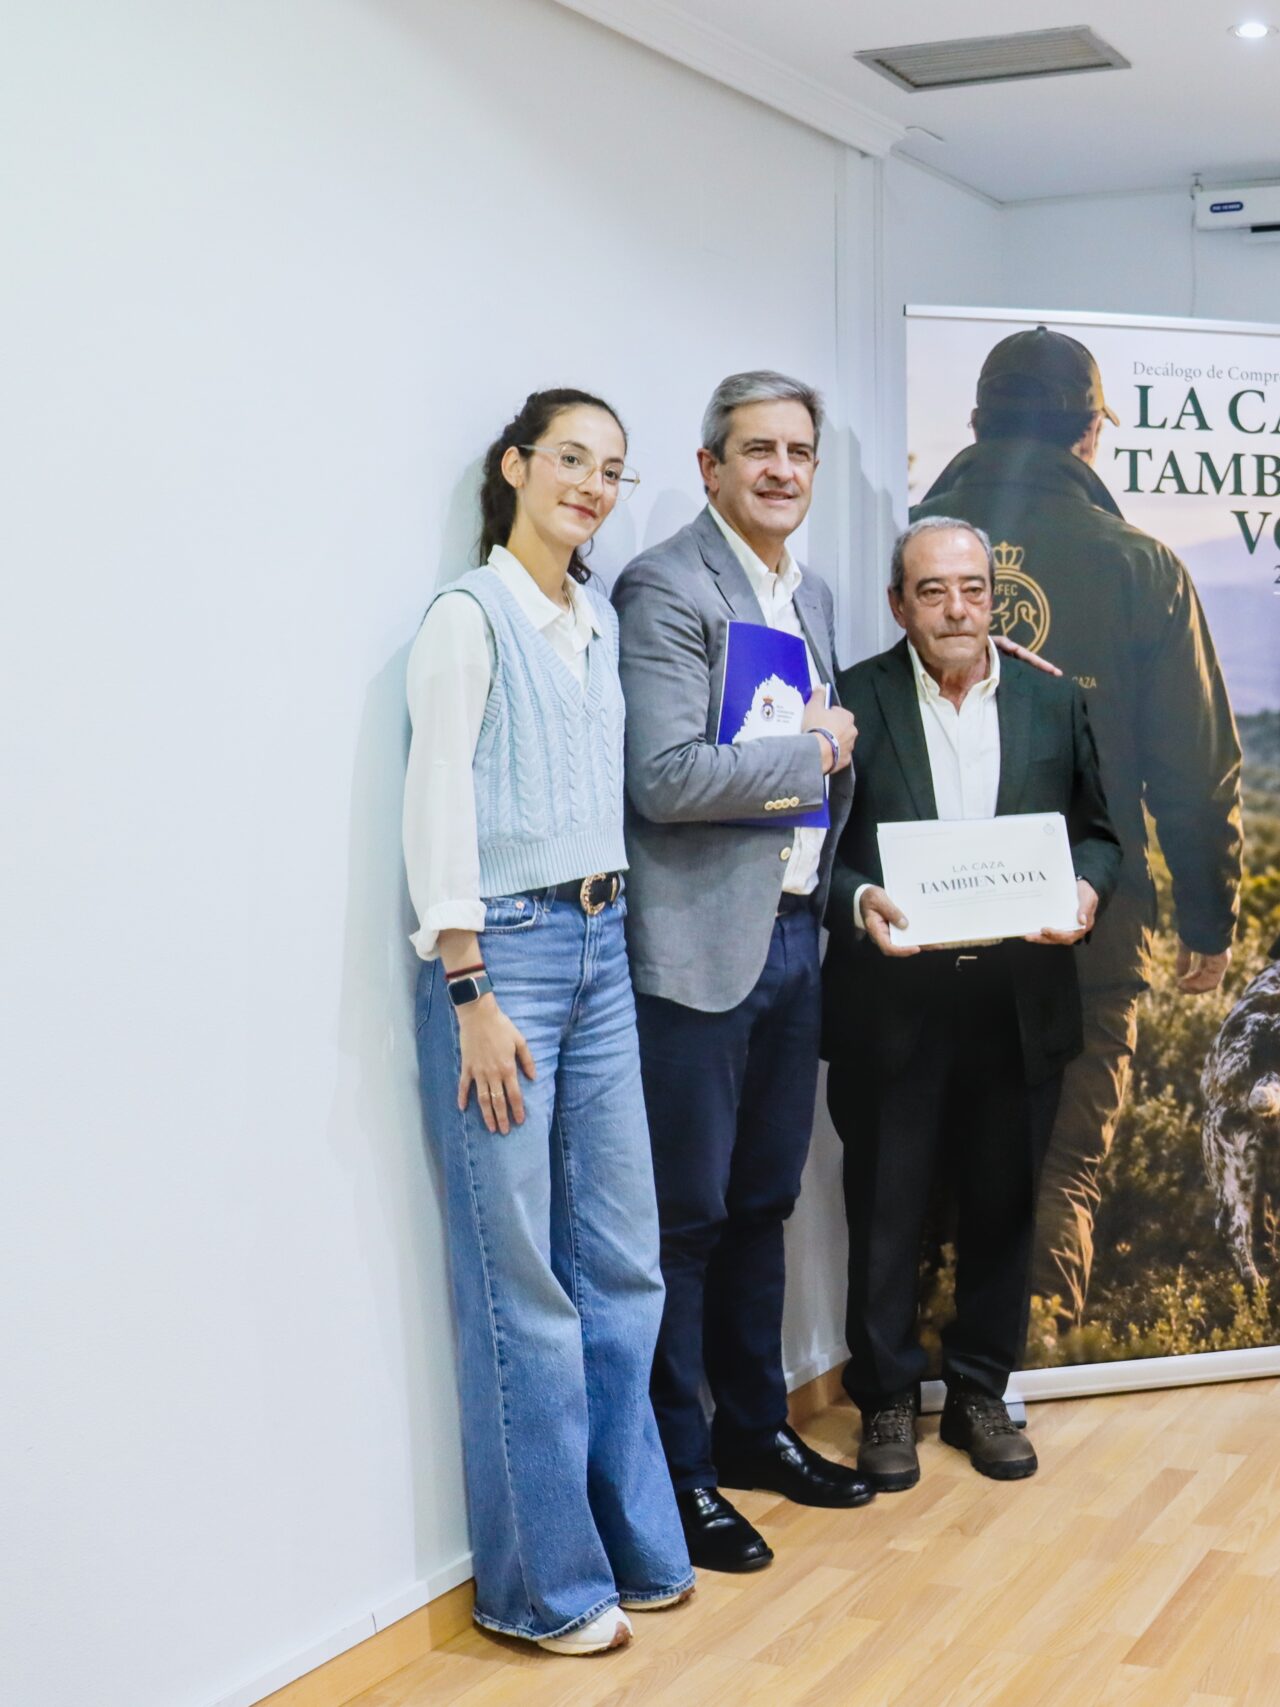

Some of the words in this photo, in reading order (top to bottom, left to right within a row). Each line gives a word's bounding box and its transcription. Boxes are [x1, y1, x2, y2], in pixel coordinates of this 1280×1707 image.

[1133, 360, 1202, 382] Decálogo
[1206, 364, 1223, 379] de
[1133, 384, 1213, 431] LA
[1001, 871, 1048, 884] VOTA
